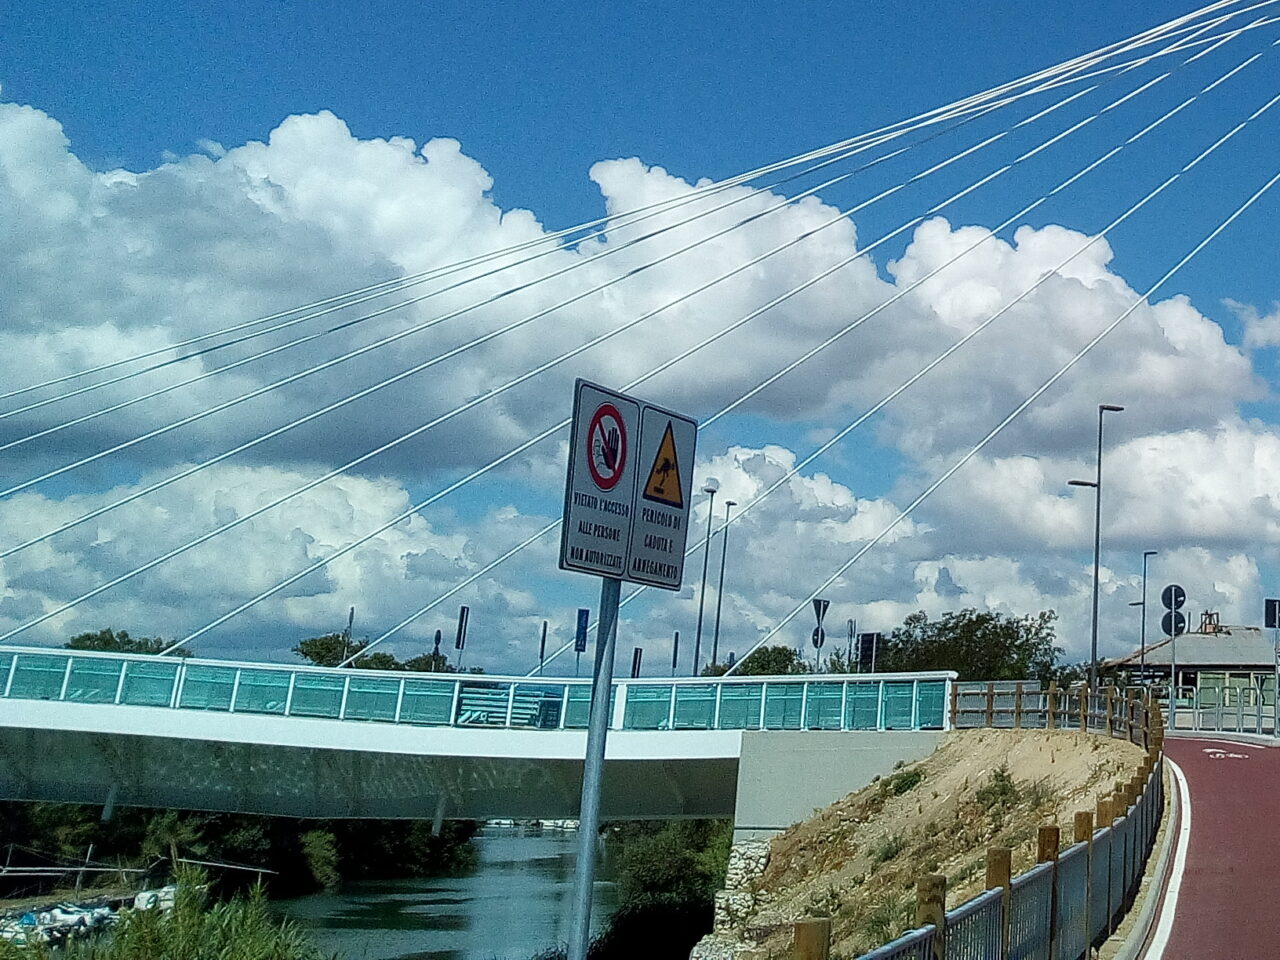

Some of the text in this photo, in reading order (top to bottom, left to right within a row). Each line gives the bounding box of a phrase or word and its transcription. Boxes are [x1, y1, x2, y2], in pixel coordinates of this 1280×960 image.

[574, 492, 629, 517] VIETATO L'ACCESSO
[642, 507, 681, 530] PERICOLO DI
[578, 520, 621, 541] ALLE PERSONE
[644, 534, 673, 553] CADUTA E
[570, 546, 622, 568] NON AUTORIZZATE
[632, 557, 678, 579] ANNEGAMENTO
